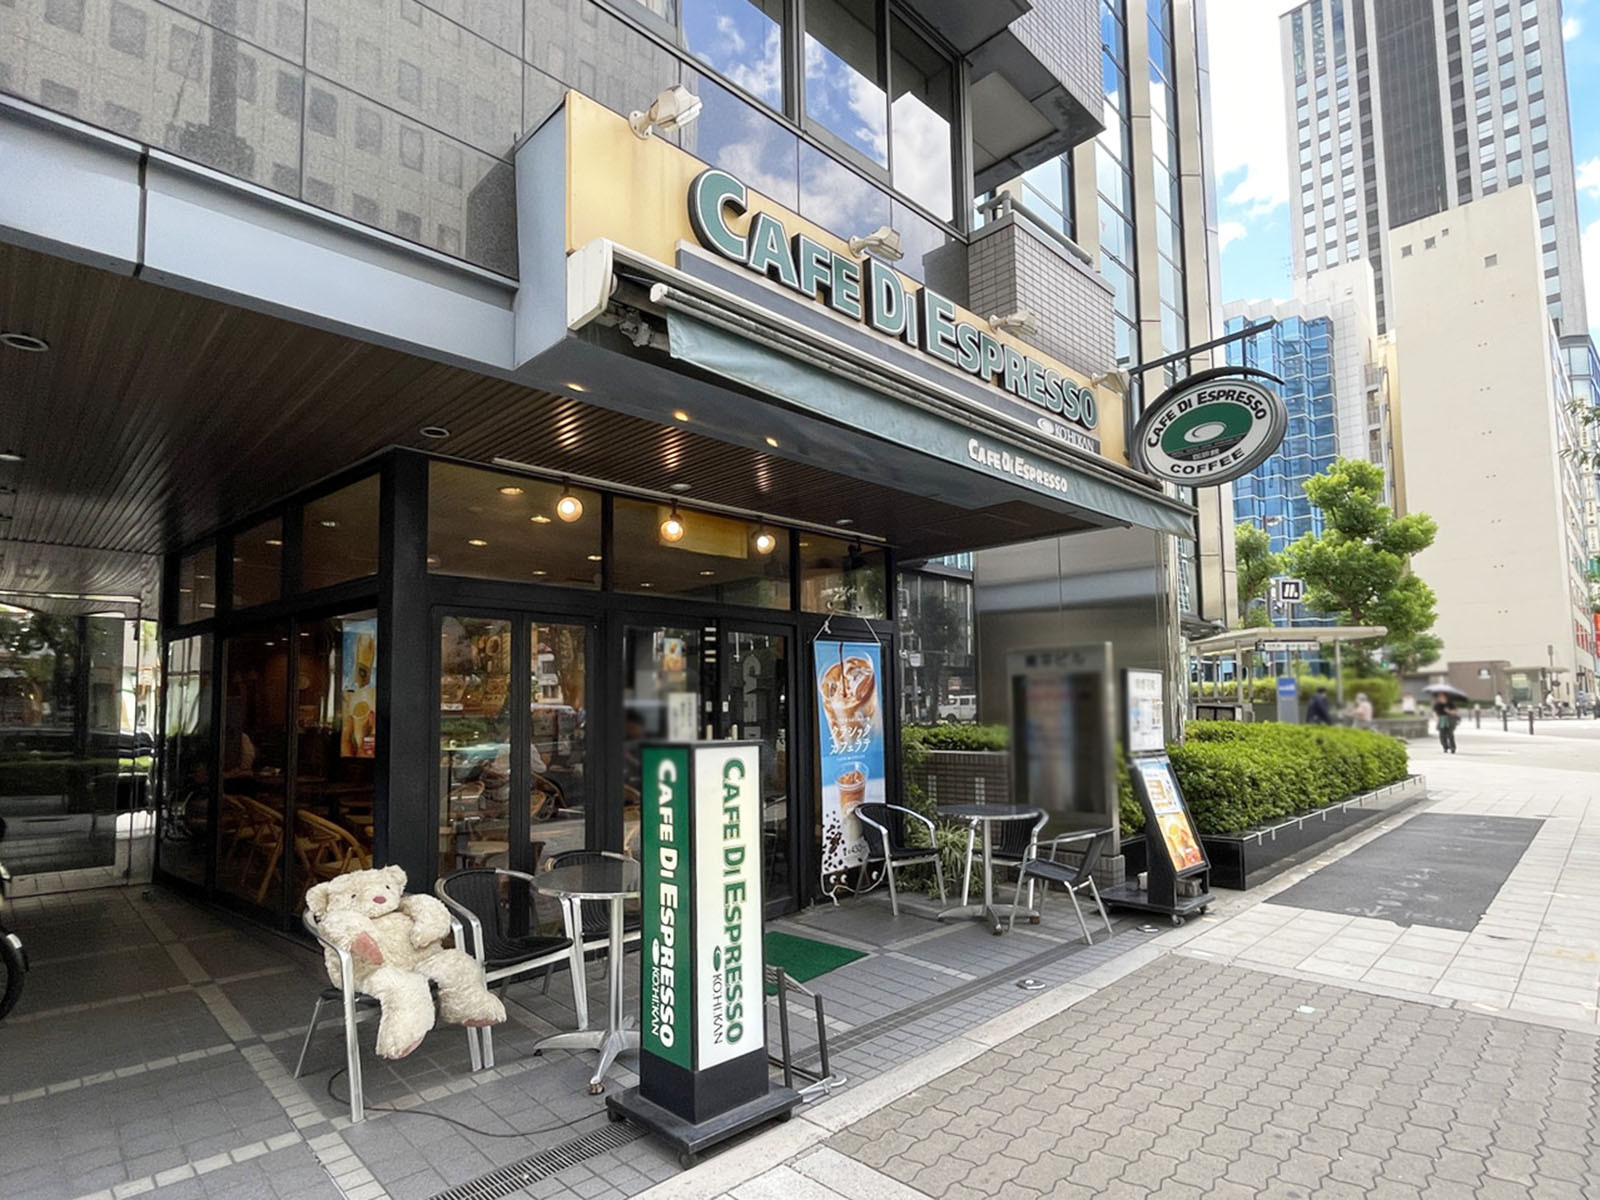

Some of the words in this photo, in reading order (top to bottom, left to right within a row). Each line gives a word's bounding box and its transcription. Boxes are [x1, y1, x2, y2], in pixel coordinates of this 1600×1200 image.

[690, 168, 864, 320] CAFE
[918, 287, 1098, 430] ESPRESSO
[1147, 410, 1177, 448] CAFE
[1177, 398, 1193, 413] DI
[1197, 389, 1267, 420] ESPRESSO
[968, 438, 1001, 470] CAFE
[1015, 456, 1068, 493] ESPRESSO
[1170, 448, 1245, 475] COFFEE
[657, 758, 677, 842] CAFE
[722, 758, 746, 840] CAFE
[659, 847, 678, 878] DI
[723, 846, 746, 877] DI
[659, 883, 678, 1048] ESPRESSO
[724, 881, 747, 1045] ESPRESSO
